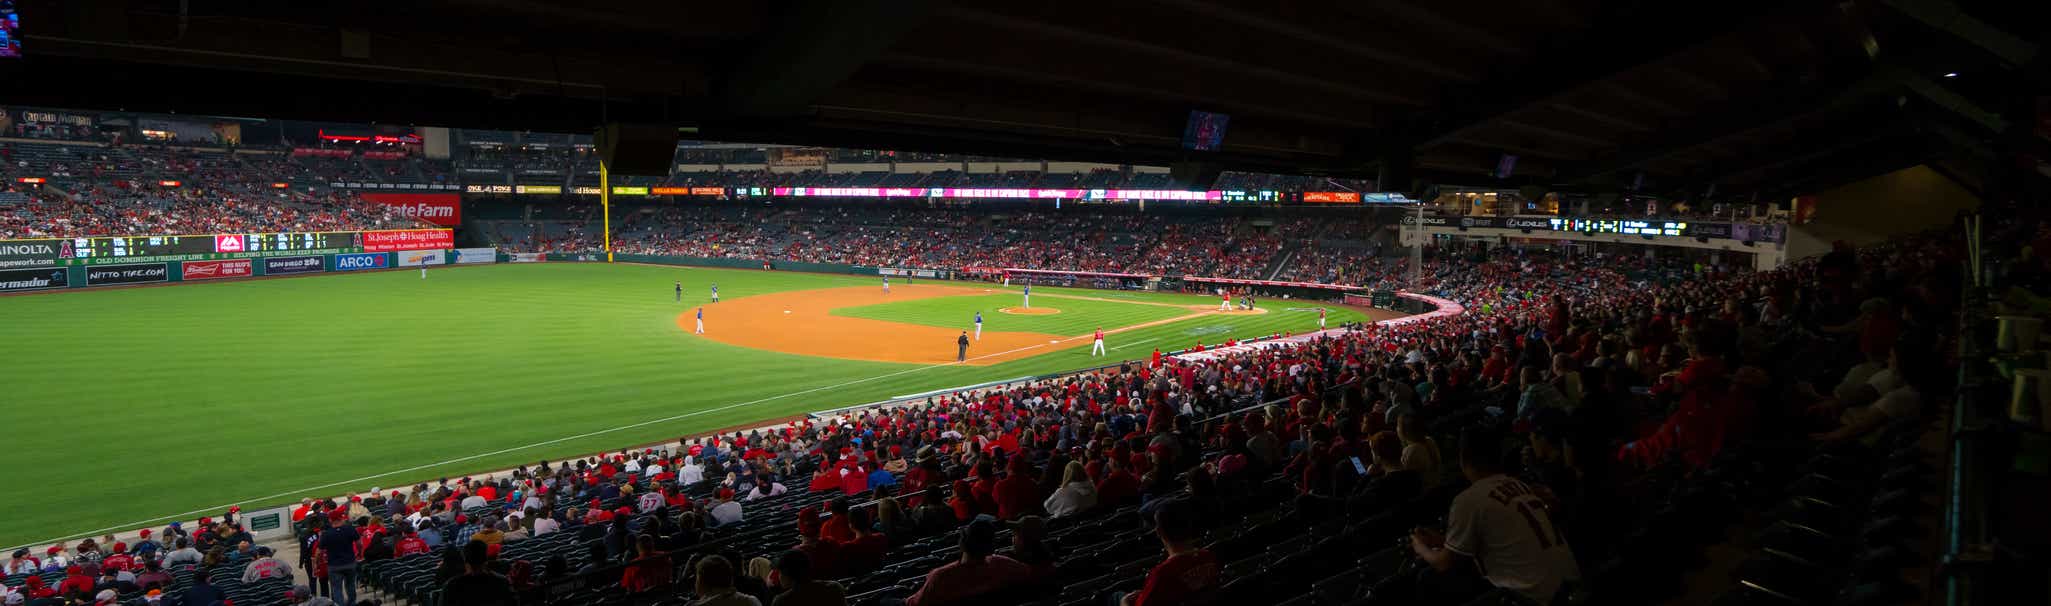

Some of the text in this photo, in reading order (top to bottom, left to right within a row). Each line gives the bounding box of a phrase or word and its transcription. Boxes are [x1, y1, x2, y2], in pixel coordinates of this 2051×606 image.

[23, 111, 92, 127] Captain Morgan
[114, 256, 155, 264] DOMINION
[340, 257, 374, 268] ARCO
[90, 271, 120, 280] NITTO
[643, 499, 657, 509] 27
